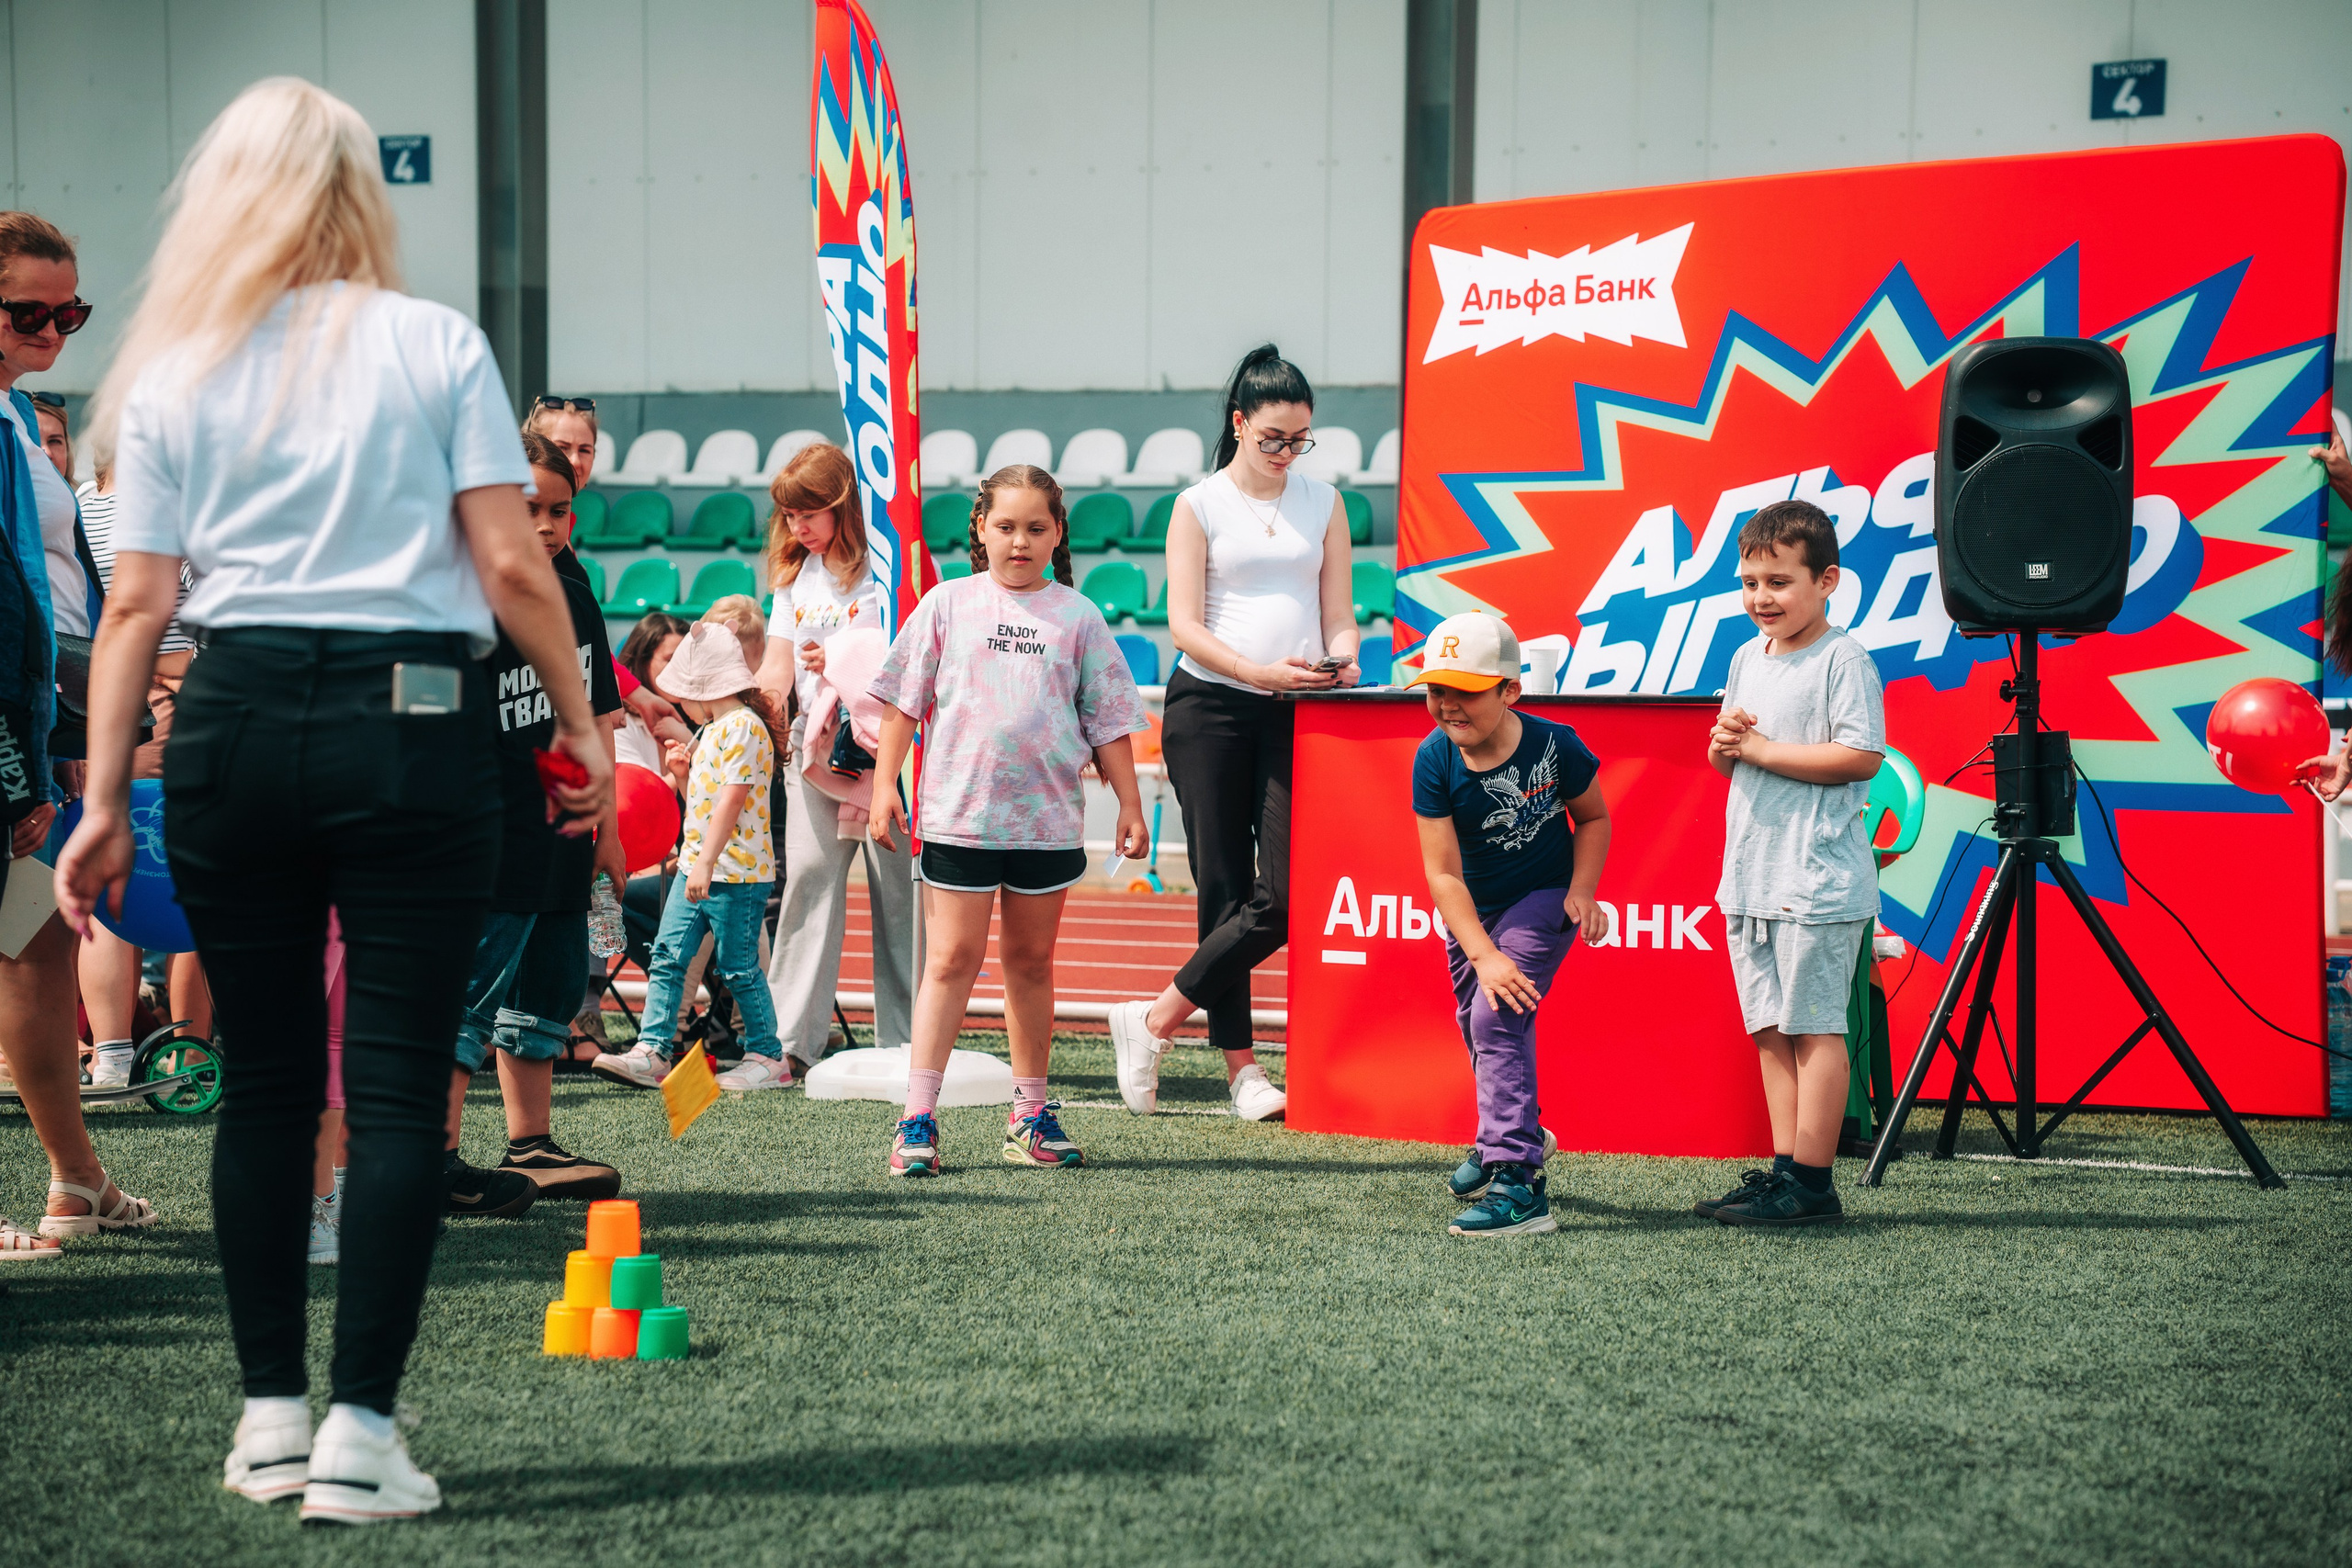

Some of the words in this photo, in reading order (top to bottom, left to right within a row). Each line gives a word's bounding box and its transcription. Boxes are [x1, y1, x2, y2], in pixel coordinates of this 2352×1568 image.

[2112, 77, 2143, 116] 4
[392, 149, 416, 182] 4
[1461, 278, 1566, 316] Альфа
[1575, 274, 1657, 305] Банк
[987, 637, 1011, 652] THE
[1014, 641, 1046, 655] NOW
[997, 624, 1038, 639] ENJOY
[1439, 635, 1460, 659] R
[1323, 875, 1448, 940] Аль
[1589, 898, 1713, 952] анк
